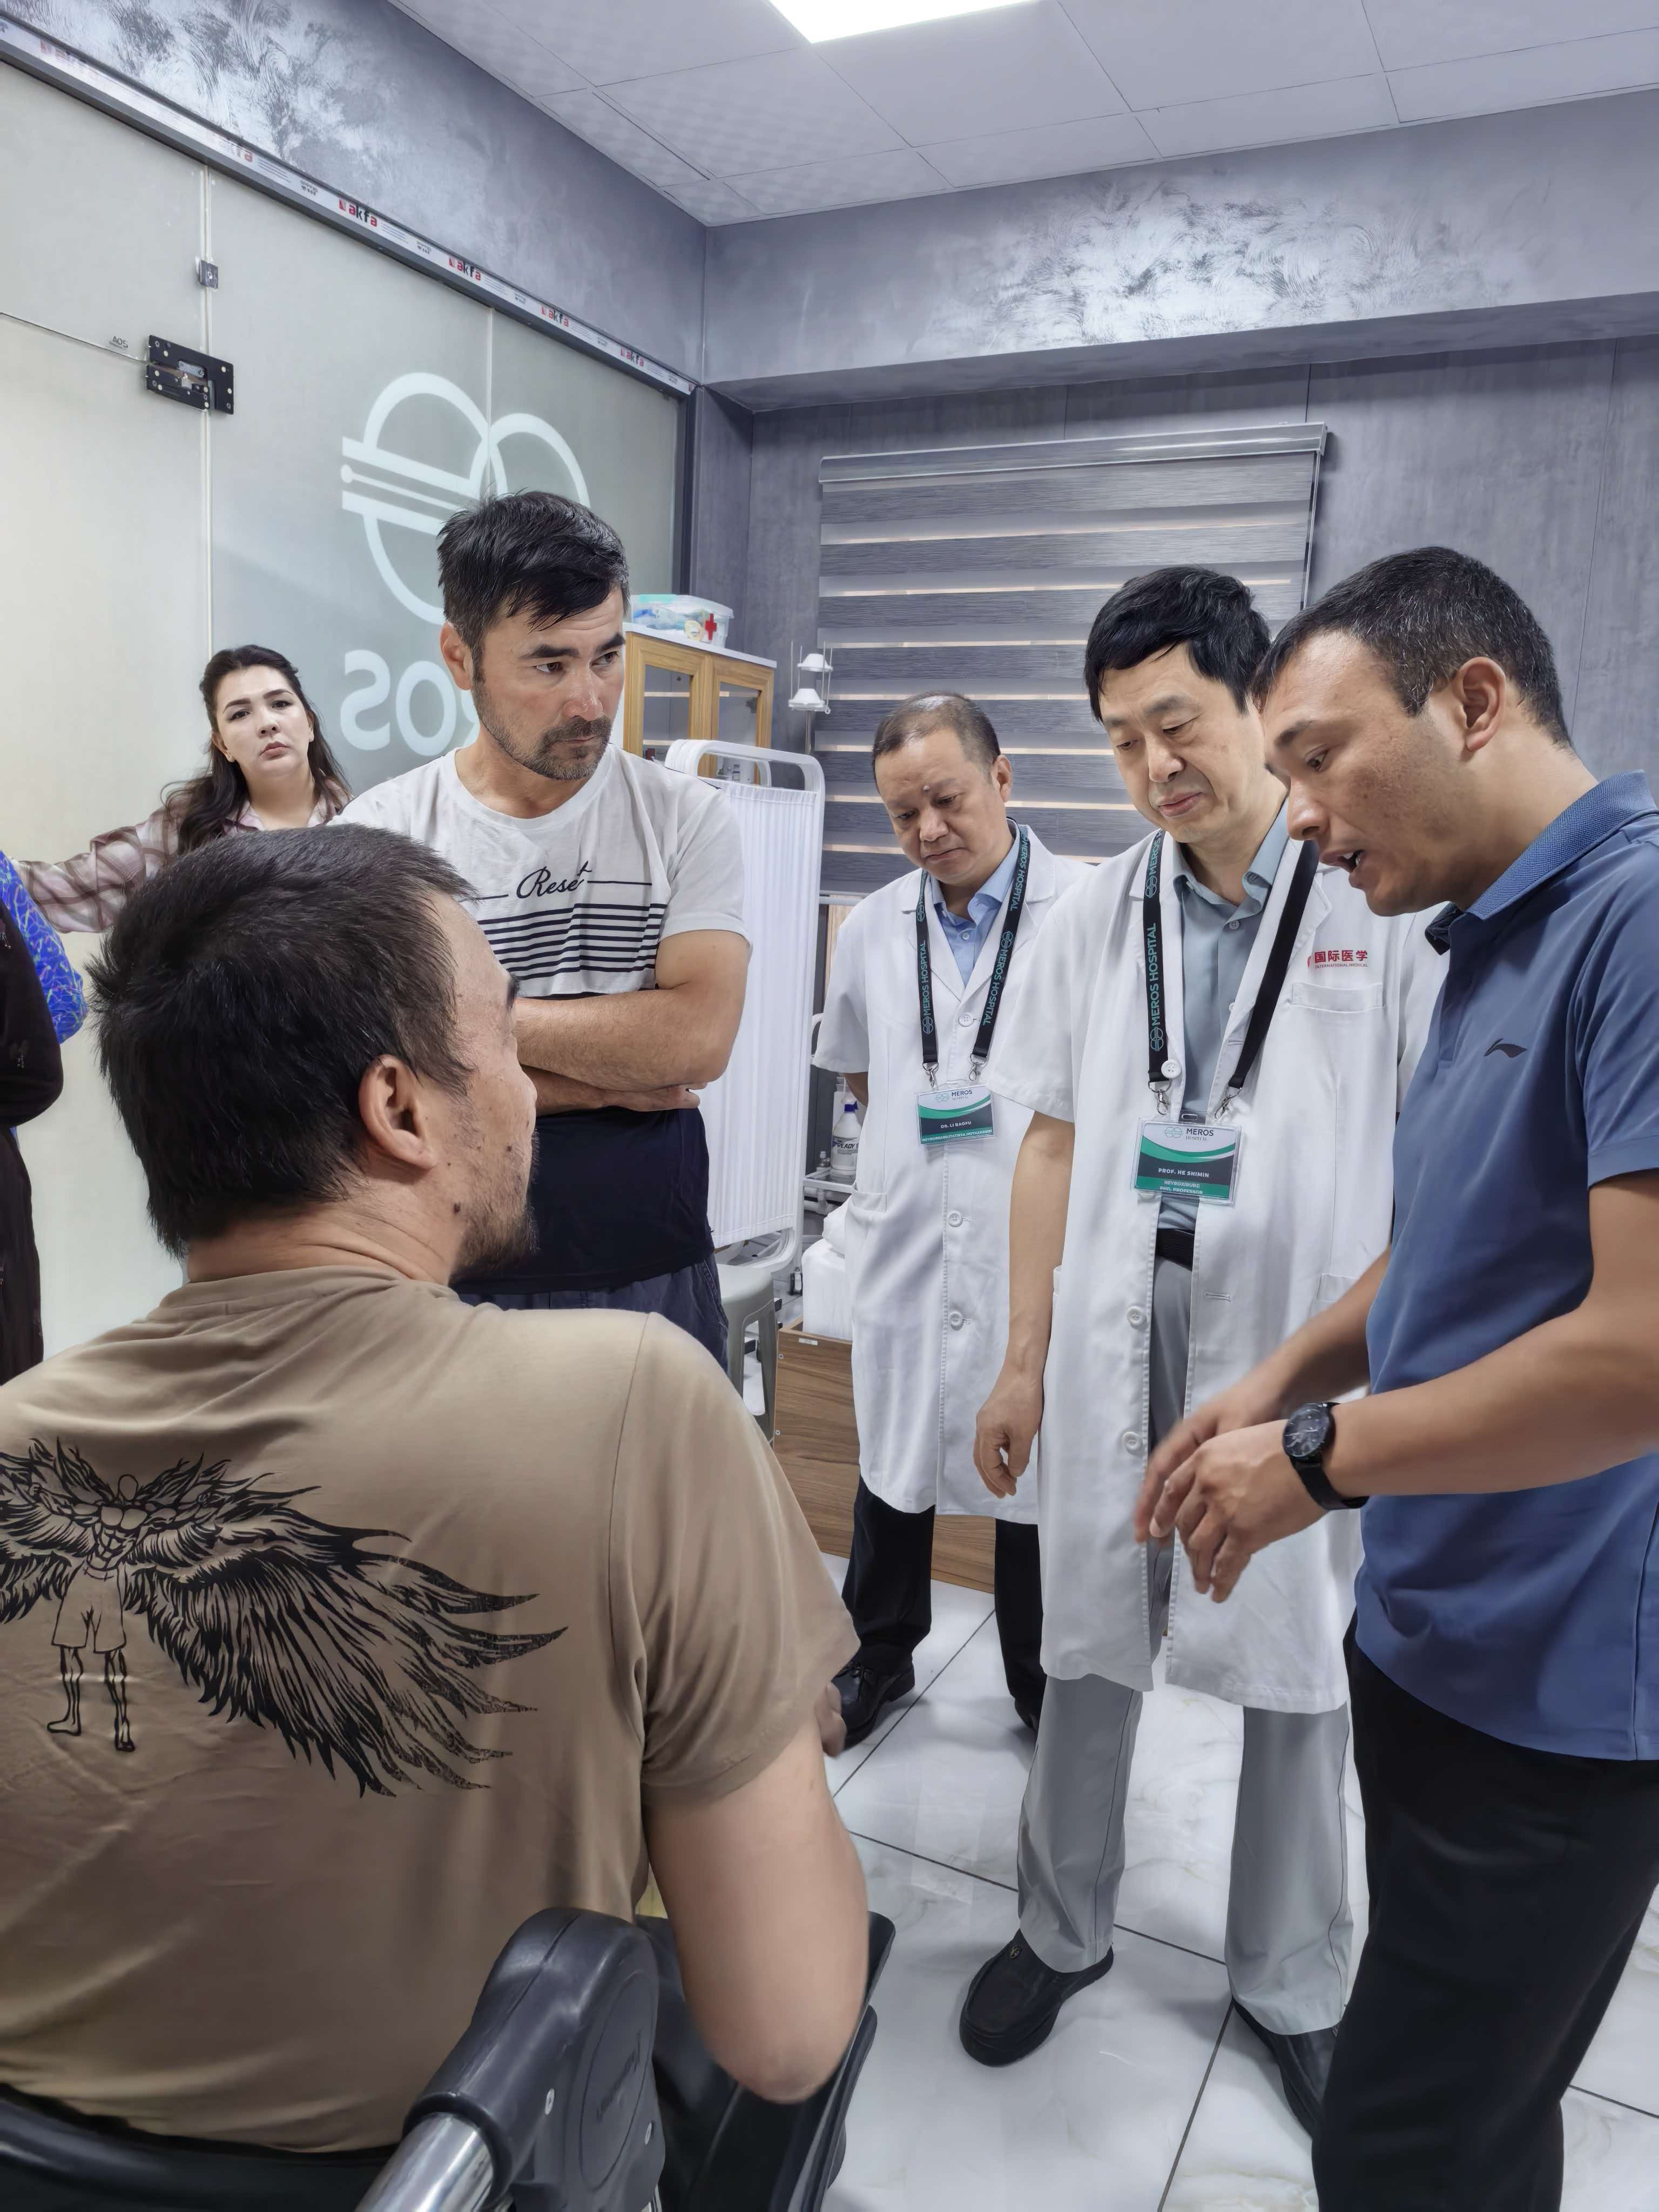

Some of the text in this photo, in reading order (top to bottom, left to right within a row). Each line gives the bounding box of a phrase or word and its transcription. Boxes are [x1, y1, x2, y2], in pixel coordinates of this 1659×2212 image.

[349, 205, 377, 227] akfa
[457, 261, 481, 281] akfa
[549, 309, 569, 327] akfa
[626, 352, 644, 367] akfa
[1149, 838, 1161, 875] MEROS
[516, 860, 592, 899] Reset
[1010, 869, 1026, 911] HOSPITAL
[1314, 950, 1367, 963] 国际医学
[920, 940, 931, 1015] MEROS HOSPITAL
[983, 949, 1008, 1026] MEROS HOSPITAL
[1147, 923, 1161, 1026] MEROS HOSPITAL
[1186, 1128, 1214, 1136] MEROS
